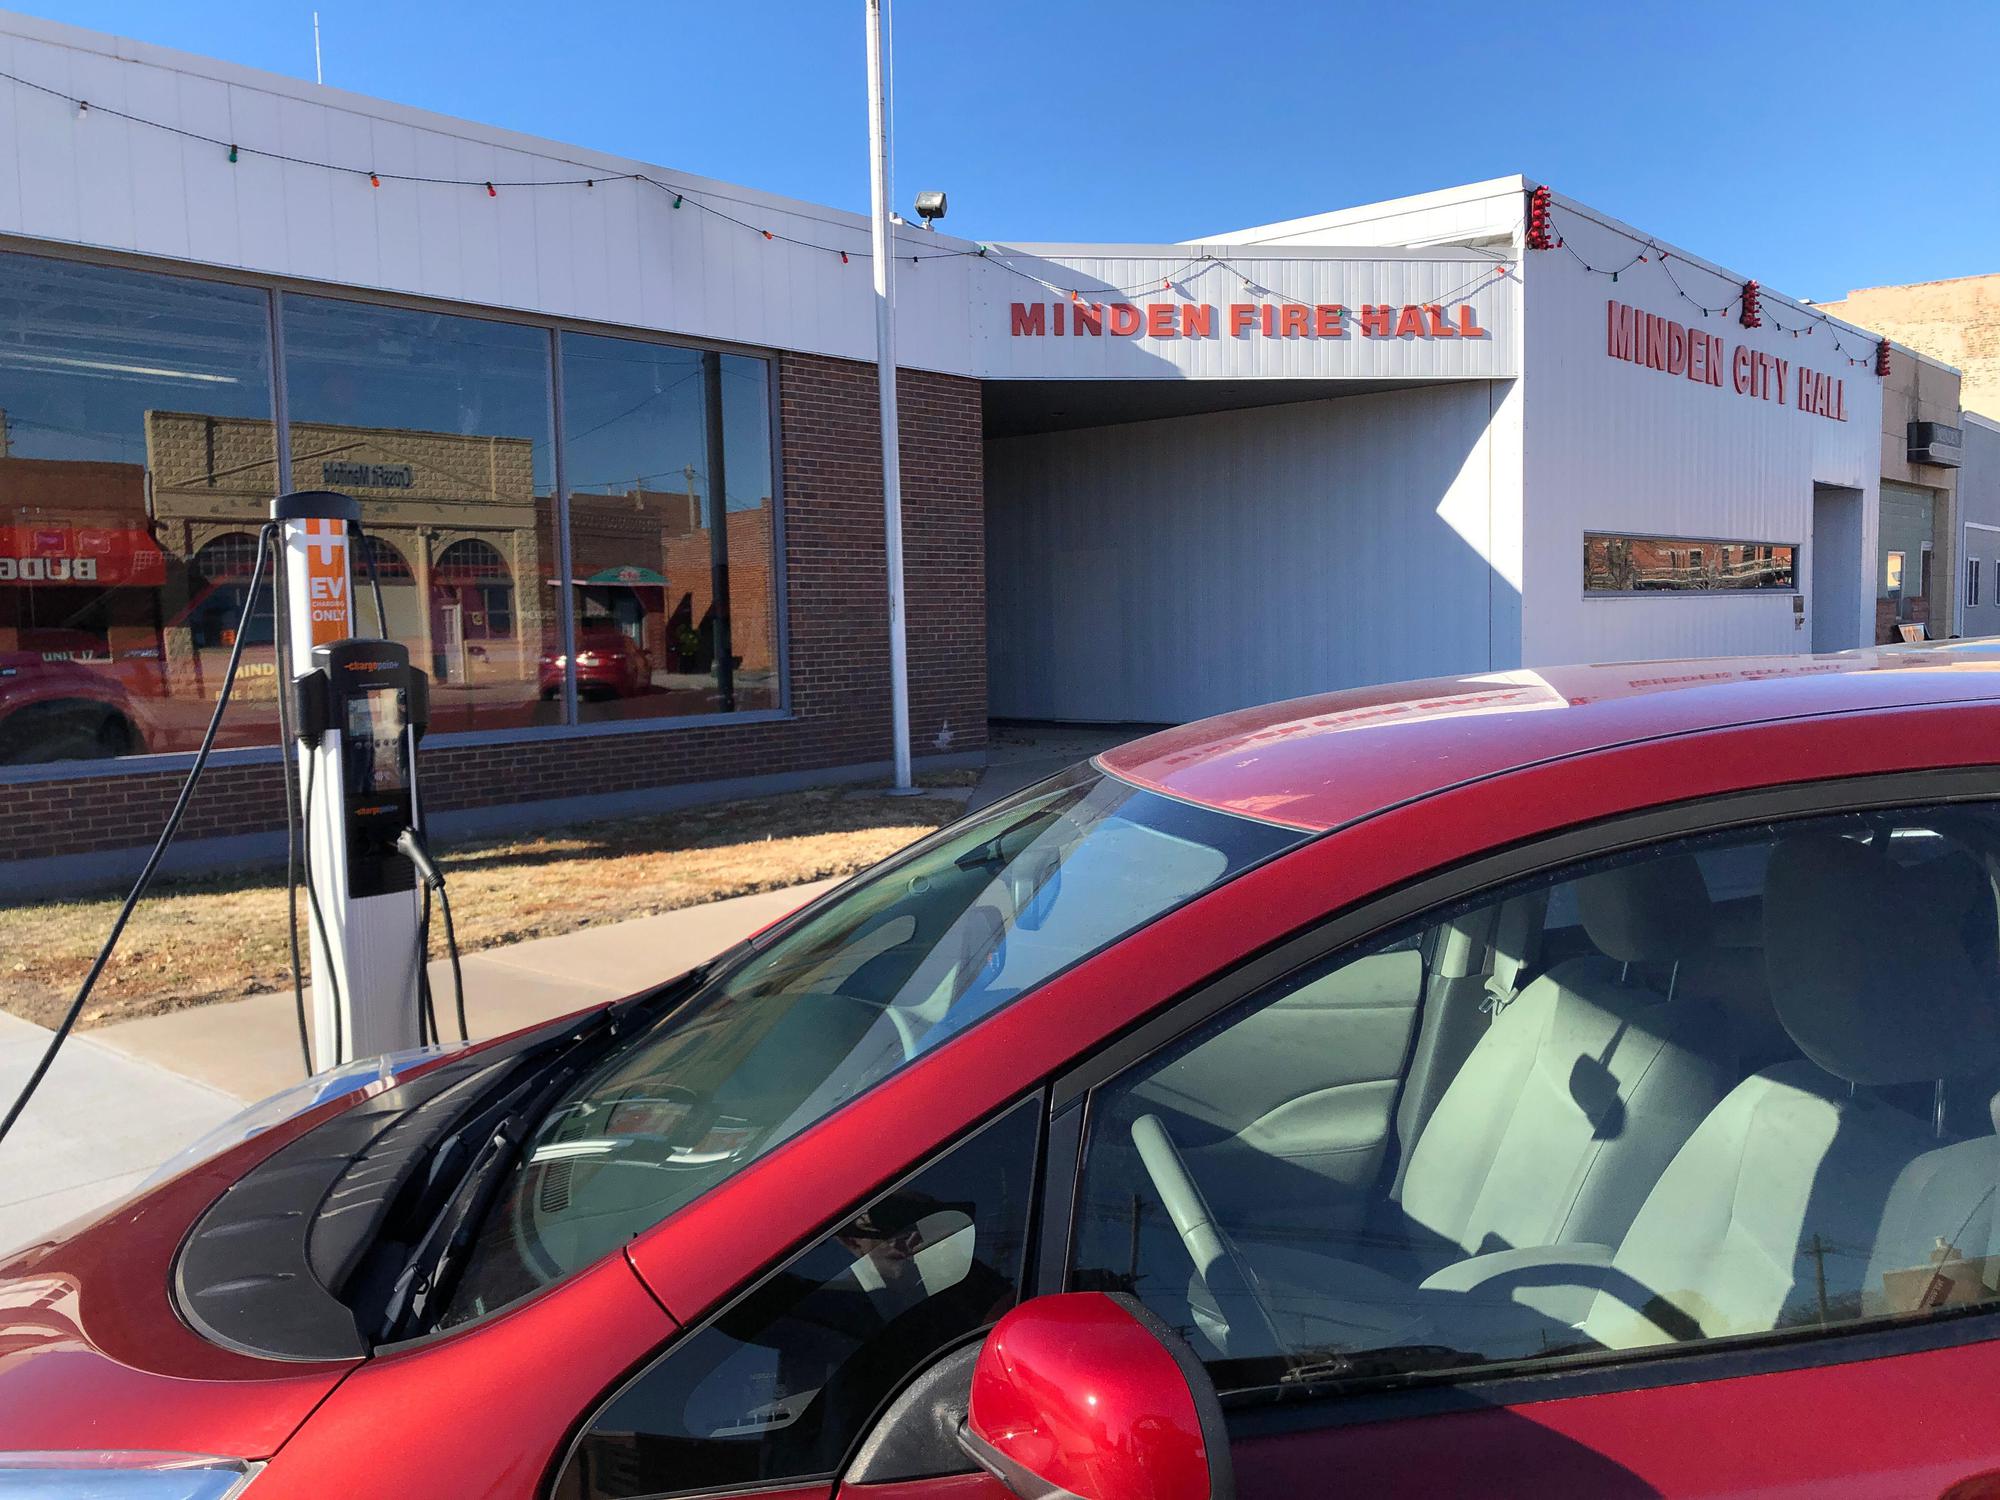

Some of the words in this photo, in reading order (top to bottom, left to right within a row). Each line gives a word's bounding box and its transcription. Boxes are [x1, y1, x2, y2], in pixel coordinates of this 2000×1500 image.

[1011, 302, 1209, 337] MINDEN
[1231, 303, 1351, 337] FIRE
[1362, 304, 1485, 337] HALL
[1608, 300, 1724, 386] MINDEN
[1733, 345, 1788, 404] CITY
[1798, 366, 1849, 422] HALL
[311, 576, 344, 598] EV
[313, 610, 345, 621] ONLY
[42, 652, 74, 662] UNIT
[344, 661, 400, 672] chargepoint
